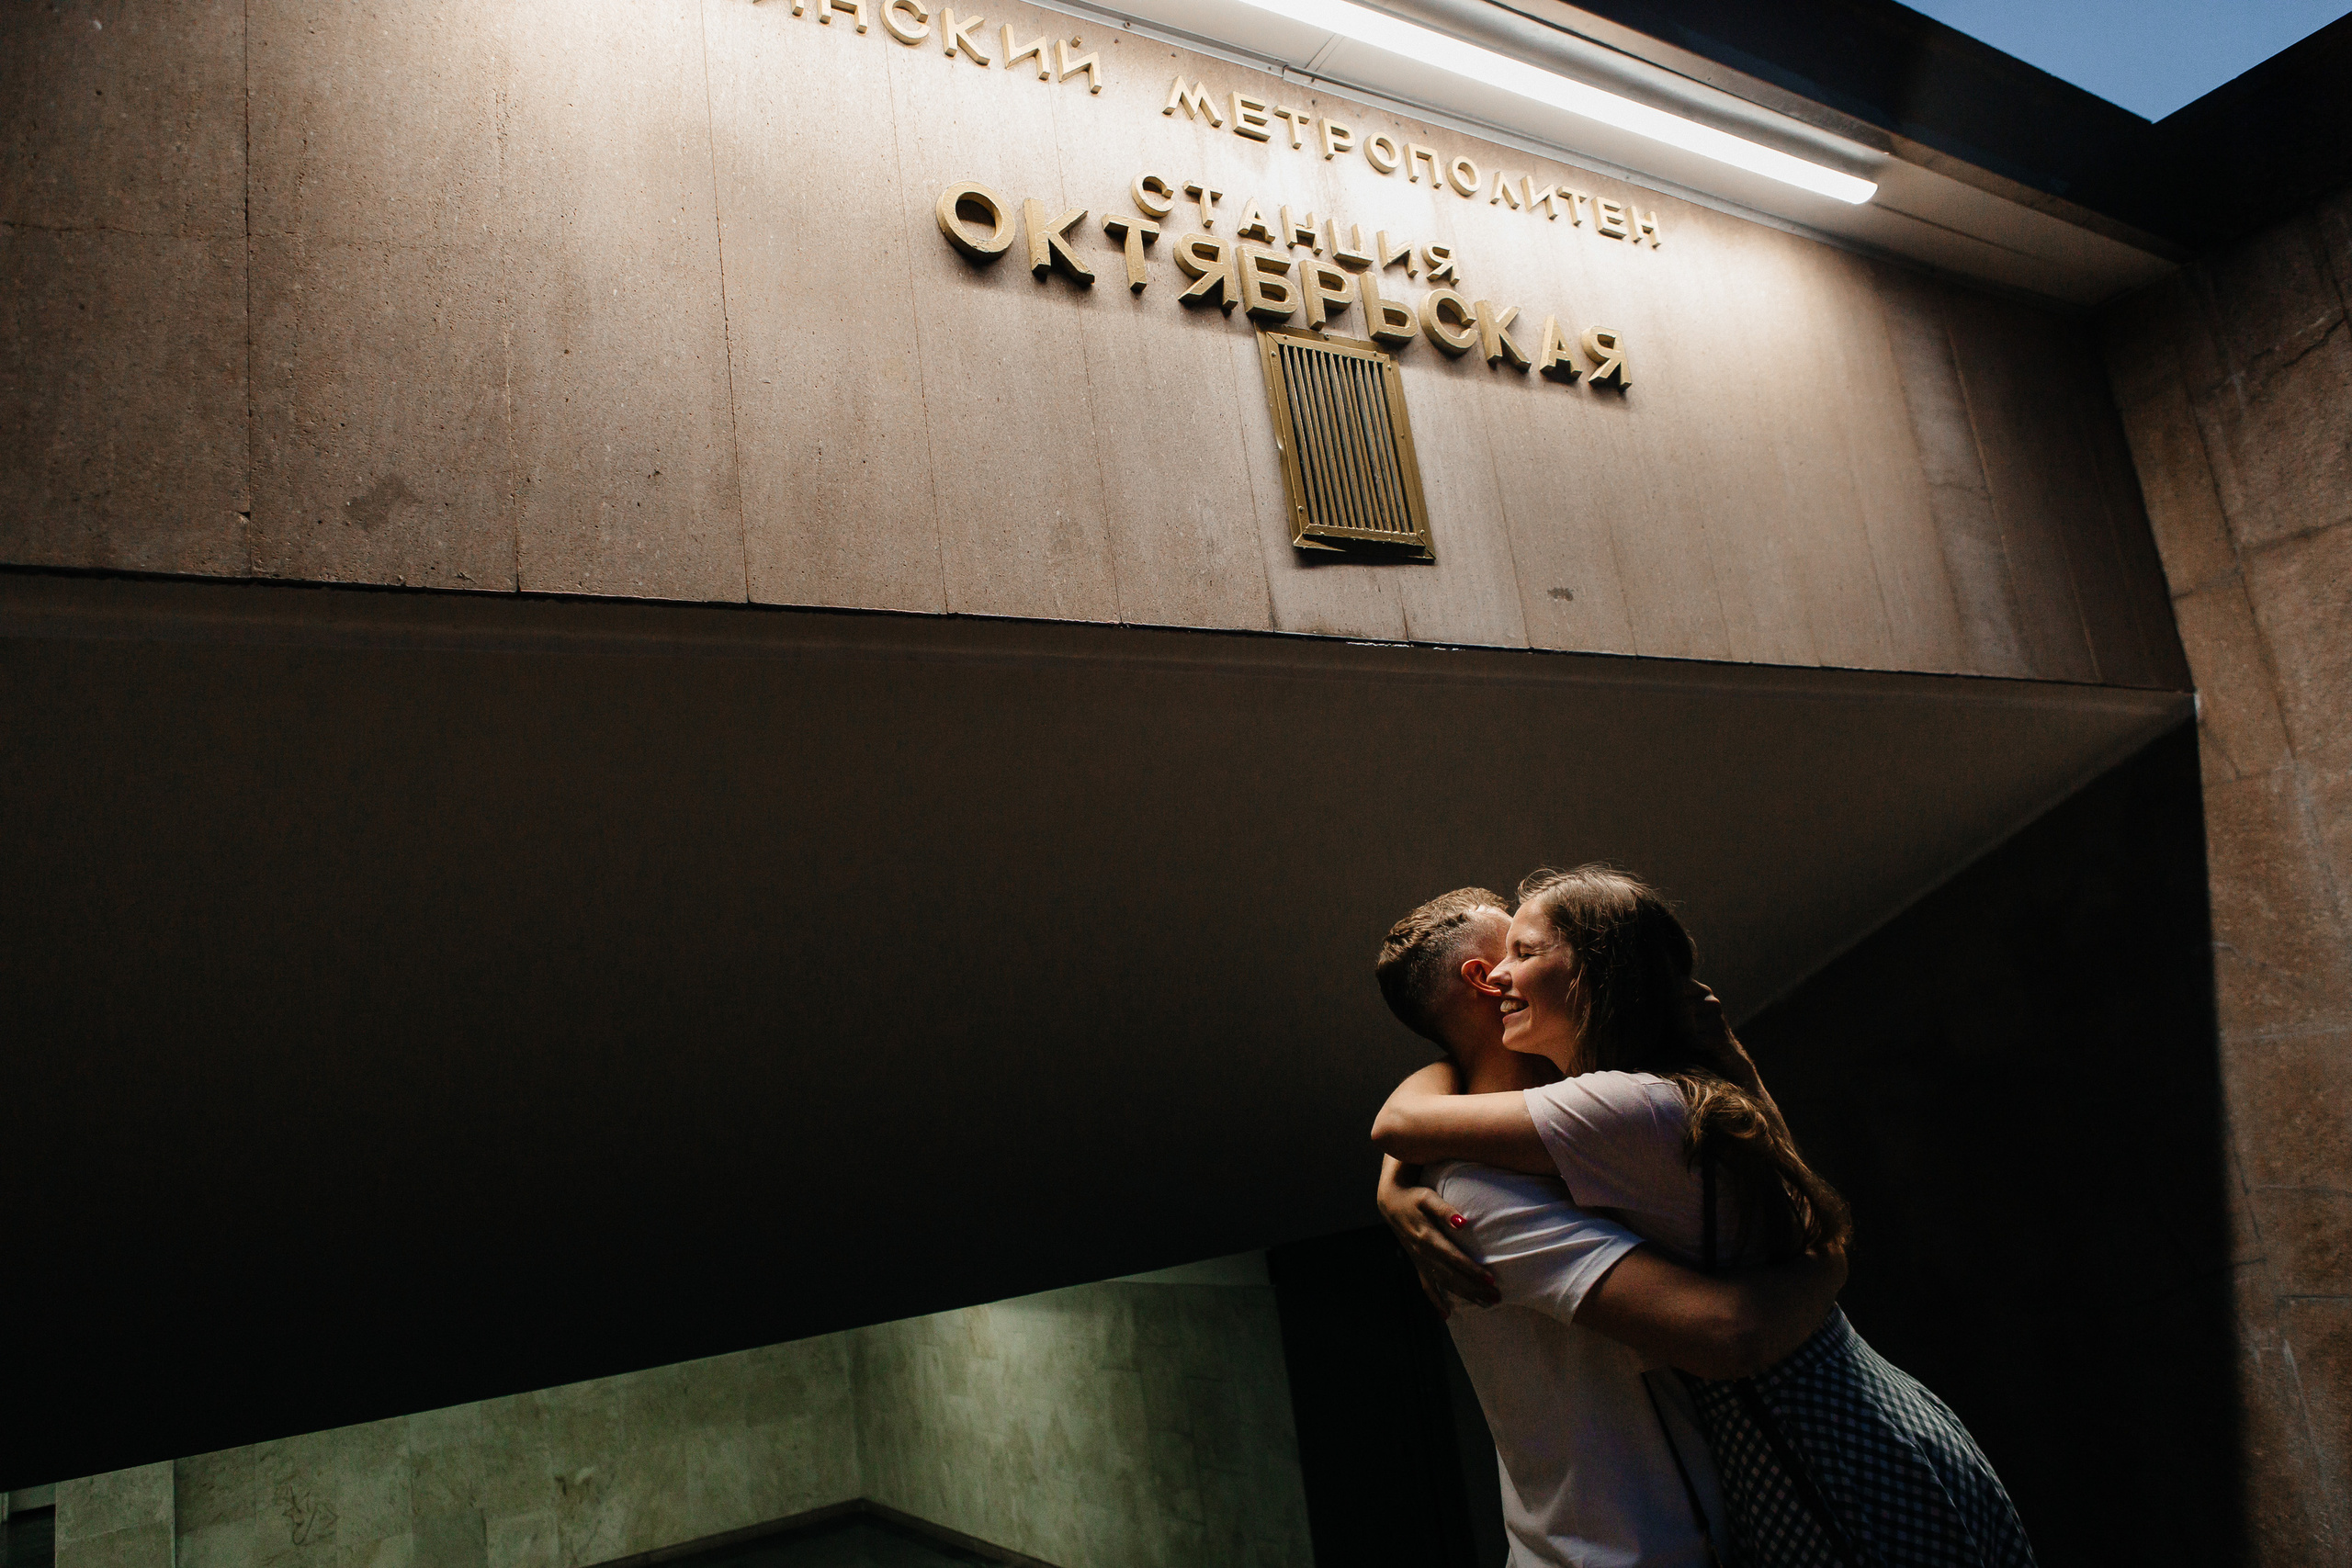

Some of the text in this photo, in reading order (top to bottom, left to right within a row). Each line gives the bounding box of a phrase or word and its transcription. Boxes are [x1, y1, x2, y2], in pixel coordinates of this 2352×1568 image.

[1131, 170, 1460, 286] СТАНЦИЯ
[1161, 75, 1662, 247] МЕТРОПОЛИТЕН
[935, 181, 1632, 391] ОКТЯБРЬСКАЯ
